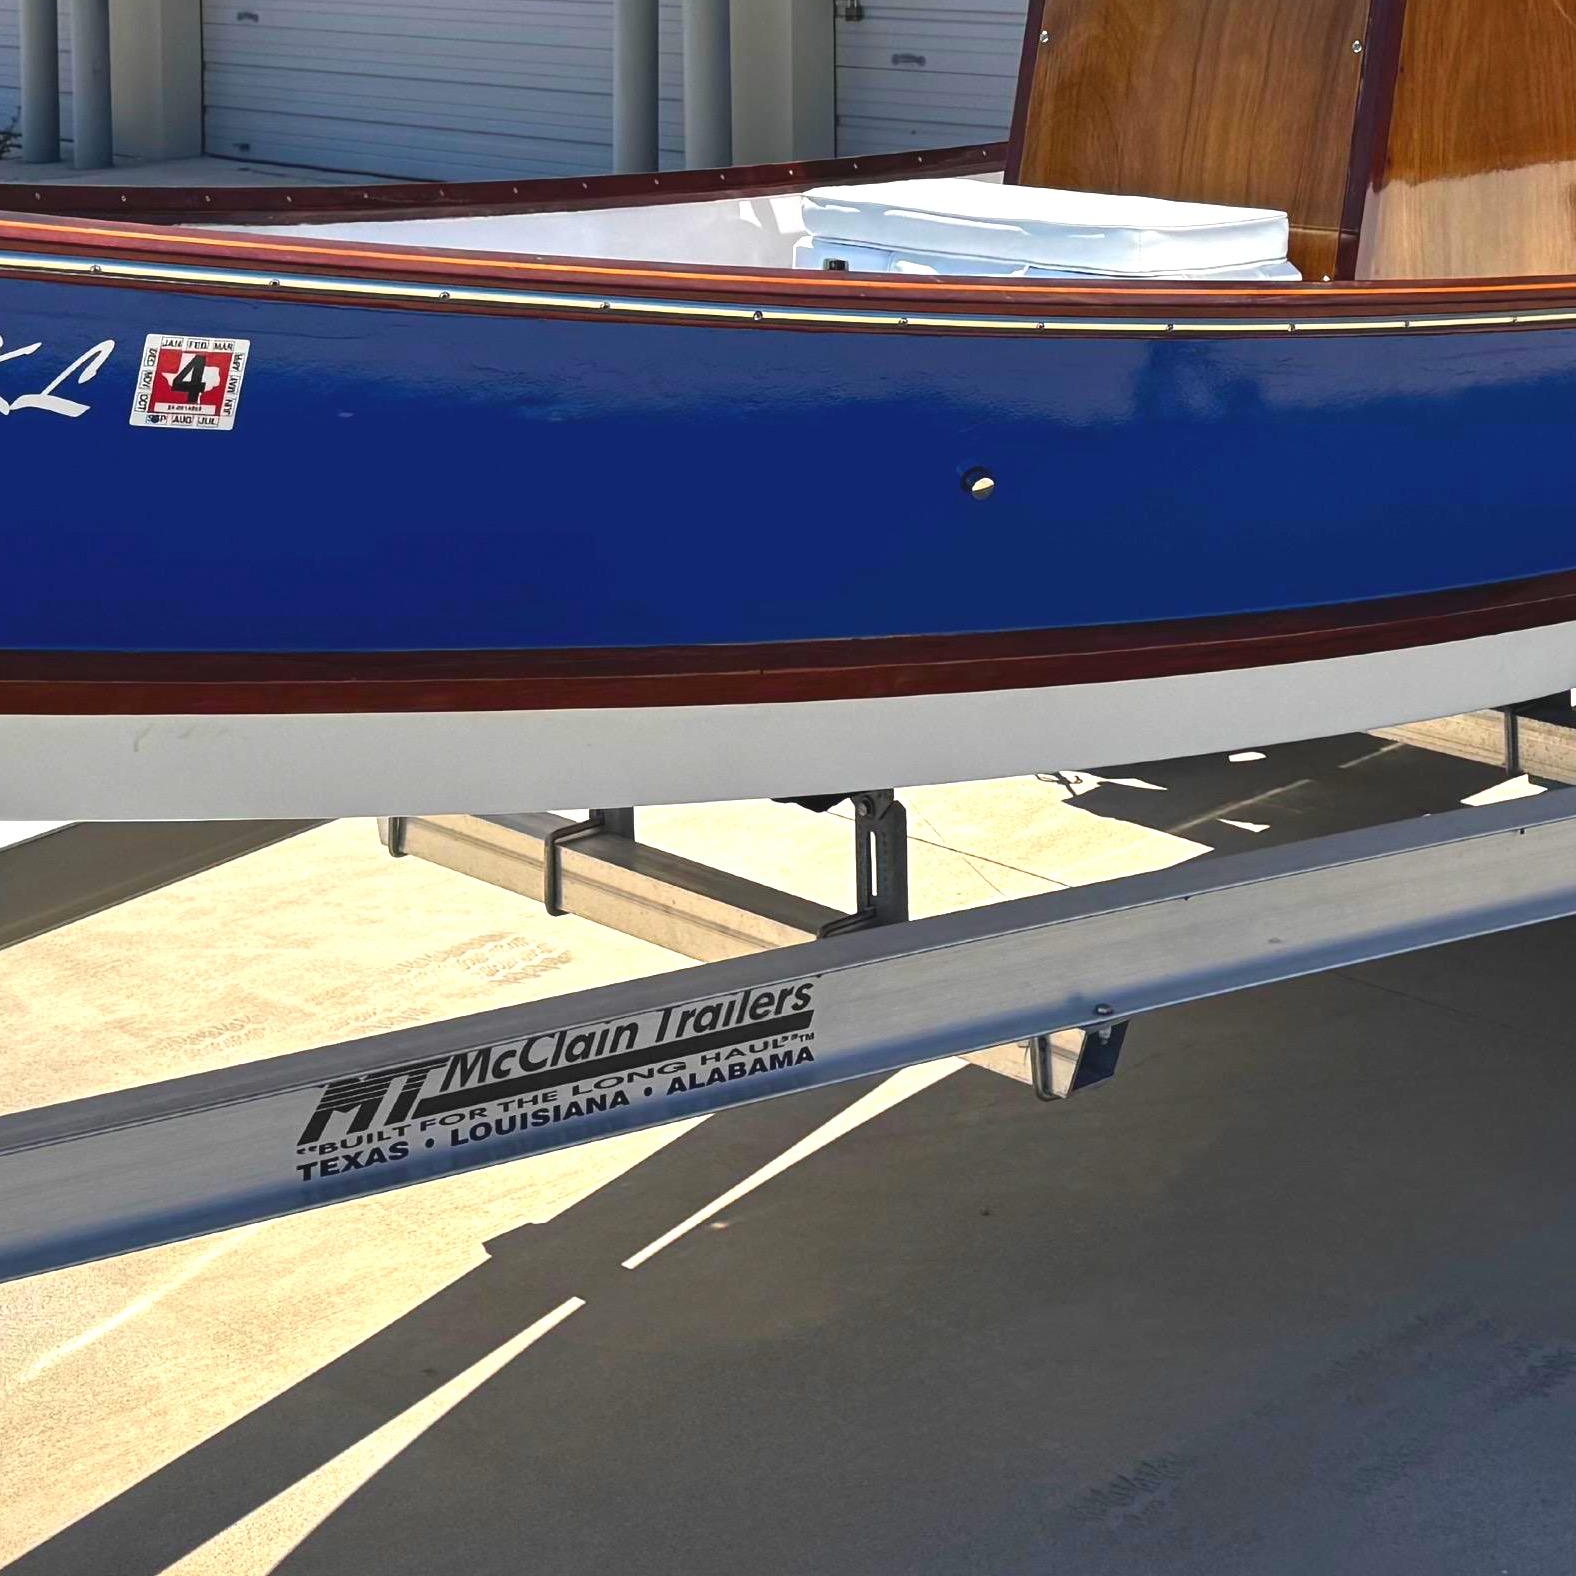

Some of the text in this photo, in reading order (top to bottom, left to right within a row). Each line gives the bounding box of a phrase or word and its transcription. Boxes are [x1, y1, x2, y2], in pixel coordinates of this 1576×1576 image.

[171, 354, 207, 404] 4
[439, 981, 815, 1093] McClain Trailers
[296, 1045, 815, 1182] TEXAS LOUISIANA ALABAMA
[420, 1107, 488, 1132] FOR
[496, 1091, 558, 1114] THE
[572, 1061, 687, 1096] LONG
